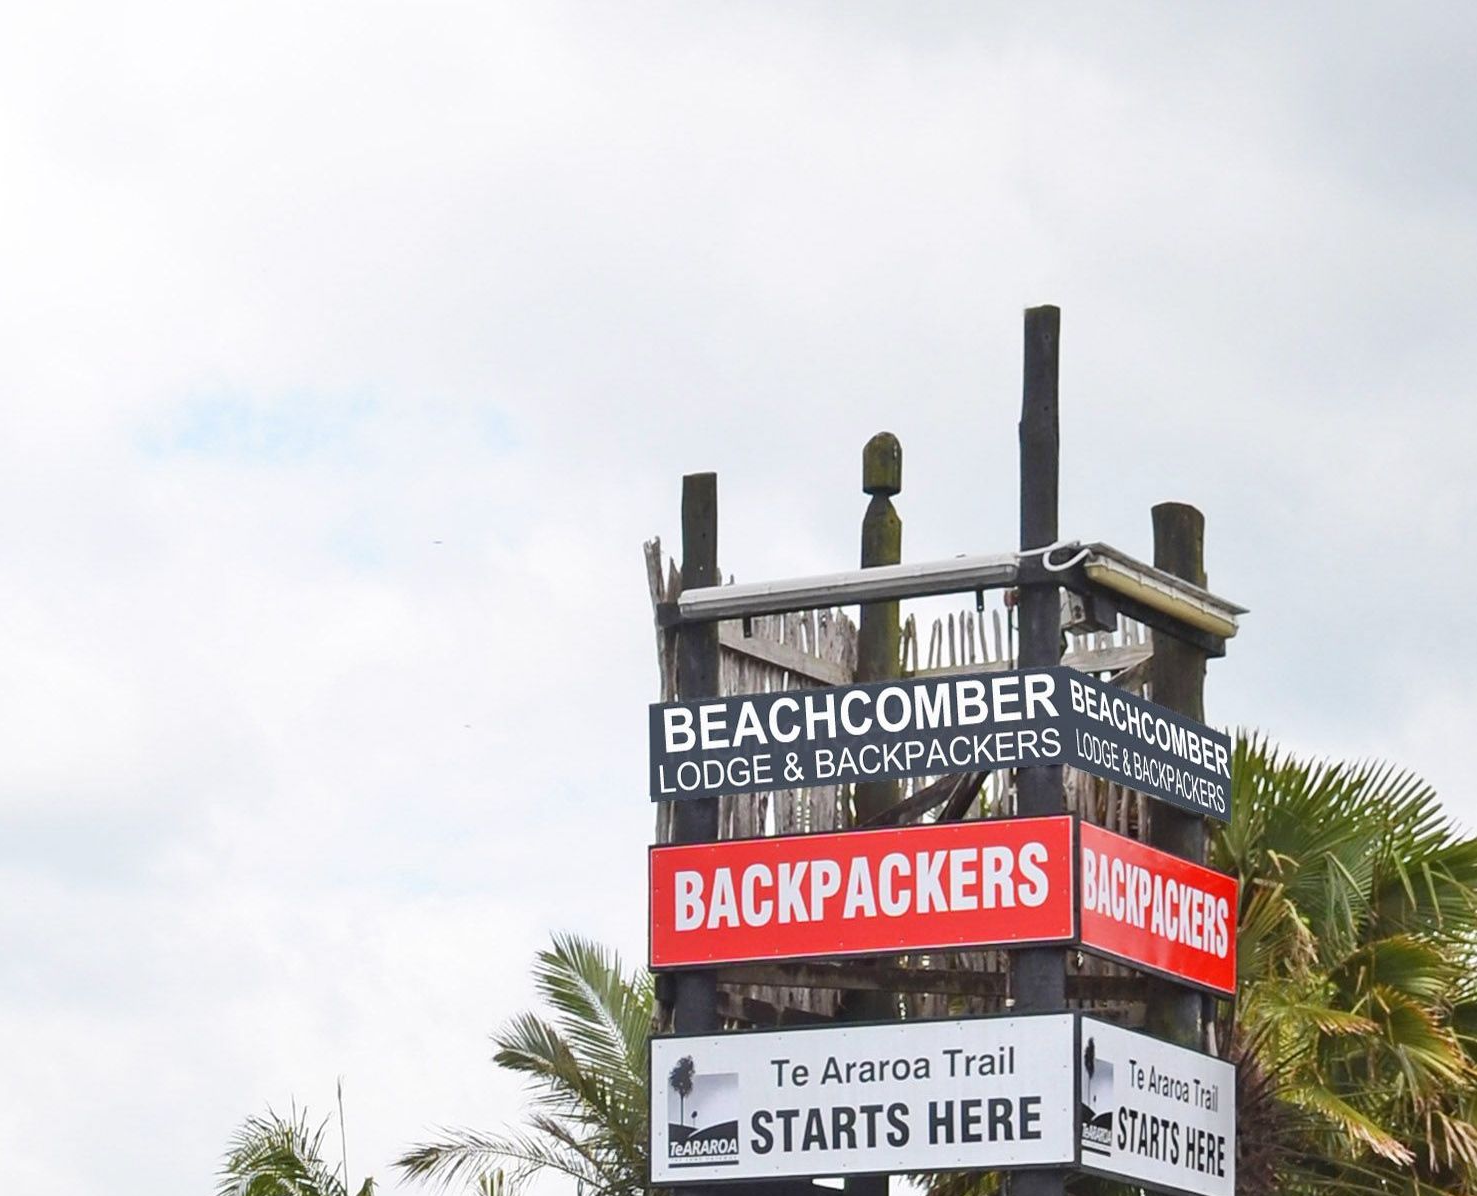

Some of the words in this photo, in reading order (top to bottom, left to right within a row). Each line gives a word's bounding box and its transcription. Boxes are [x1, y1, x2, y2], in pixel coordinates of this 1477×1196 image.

[662, 672, 1061, 753] BEACHCOMBER
[1069, 678, 1232, 780] BEACHCOMBER
[658, 755, 773, 794] LODGE
[783, 752, 807, 782] &
[815, 727, 1063, 780] BACKPACKERS
[1075, 728, 1121, 772] LODGE
[1122, 747, 1132, 777] &
[1133, 751, 1226, 814] BACKPACKERS
[674, 841, 1051, 932] BACKPACKERS
[1081, 847, 1230, 959] BACKPACKERS
[770, 1058, 809, 1087] Te
[821, 1055, 931, 1086] Araroa
[942, 1047, 1015, 1078] Trail
[1129, 1059, 1145, 1090] Te
[1148, 1065, 1190, 1103] Araroa
[1193, 1078, 1219, 1113] Trail
[750, 1102, 911, 1156] STARTS
[928, 1096, 1042, 1145] HERE
[1117, 1105, 1180, 1166] STARTS
[1185, 1126, 1225, 1178] HERE
